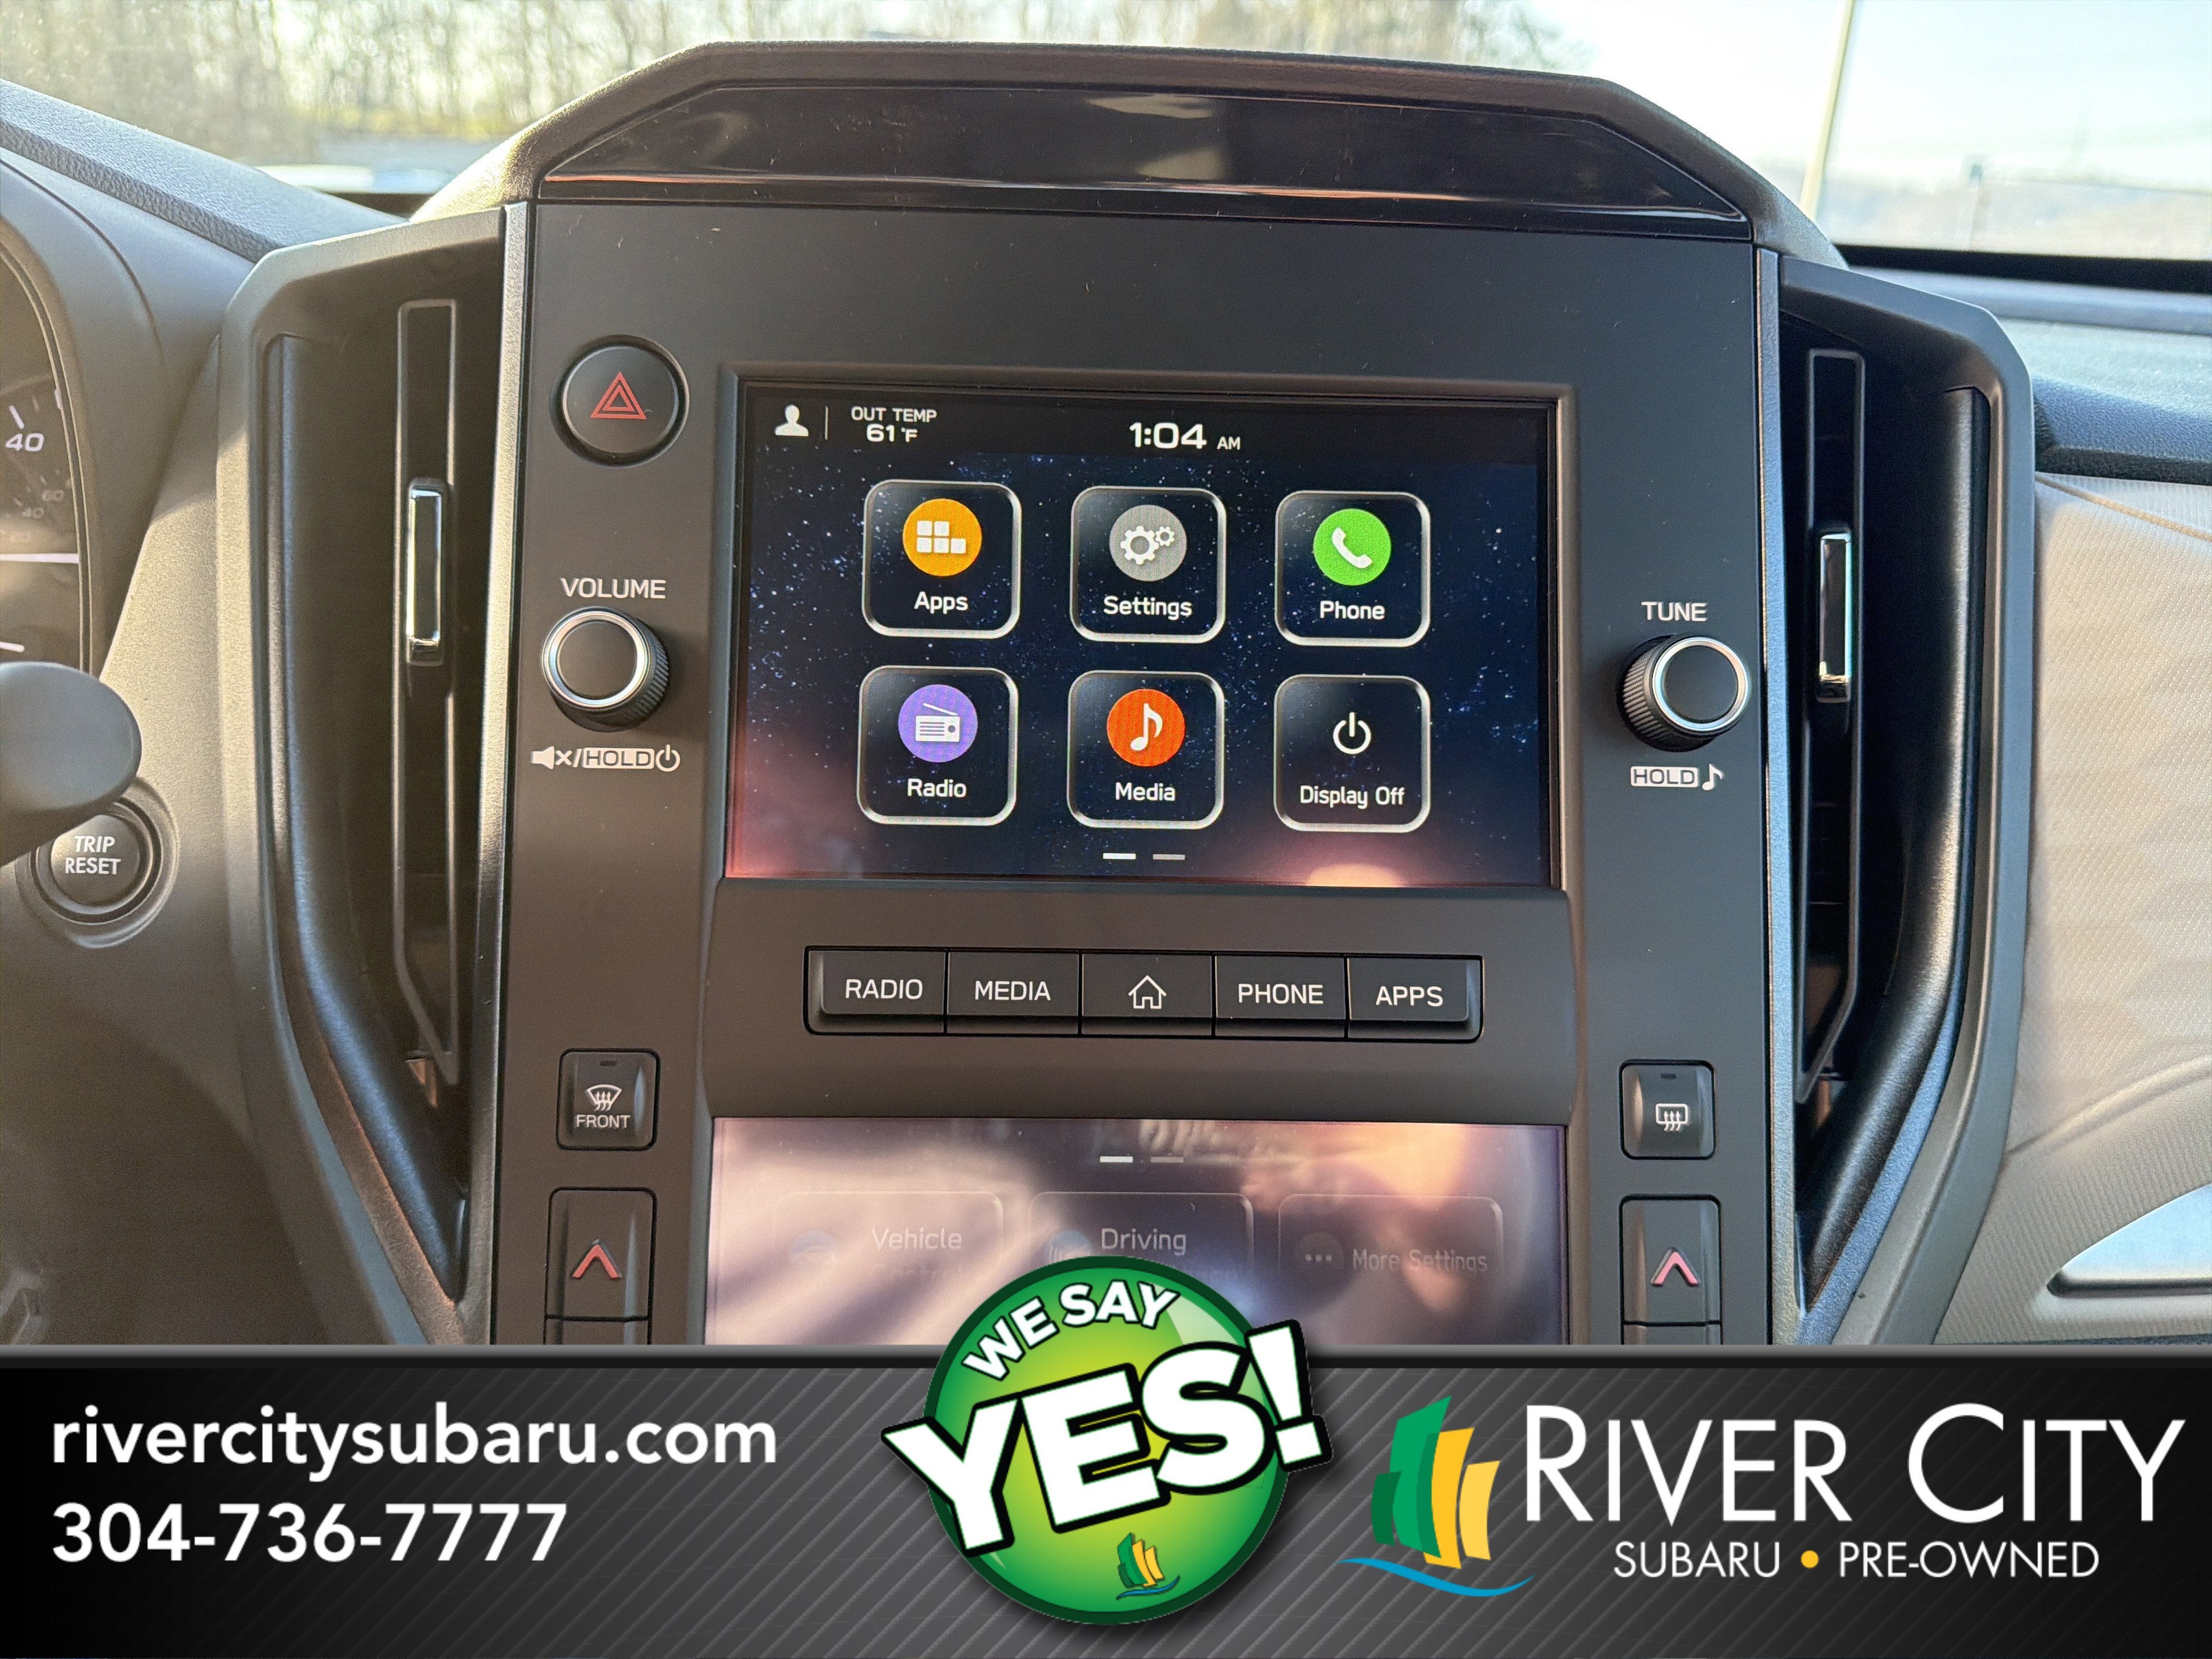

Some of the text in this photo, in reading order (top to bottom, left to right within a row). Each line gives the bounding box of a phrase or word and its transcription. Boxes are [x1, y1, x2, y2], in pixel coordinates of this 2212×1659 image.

[851, 406, 938, 423] OUT TEMP
[5, 432, 44, 452] 40
[1129, 422, 1240, 450] 1:04 AM
[560, 578, 667, 599] VOLUME
[914, 591, 968, 614] Apps
[1103, 595, 1192, 620] Settings
[1320, 600, 1385, 620] Phone
[1641, 601, 1707, 622] TUNE
[1632, 767, 1698, 787] HOLD
[907, 778, 967, 798] Radio
[1115, 782, 1176, 802] Media
[1300, 785, 1404, 810] Display Off
[75, 836, 115, 853] TRIP
[65, 857, 121, 875] RESET
[845, 979, 923, 1000] RADIO
[975, 980, 1051, 1001] MEDIA
[1238, 983, 1324, 1005] PHONE
[1375, 986, 1443, 1007] APPS
[575, 1114, 631, 1128] FRONT
[872, 1227, 962, 1250] Vehicle
[1101, 1228, 1187, 1255] Driving
[1352, 1248, 1488, 1276] More Settings
